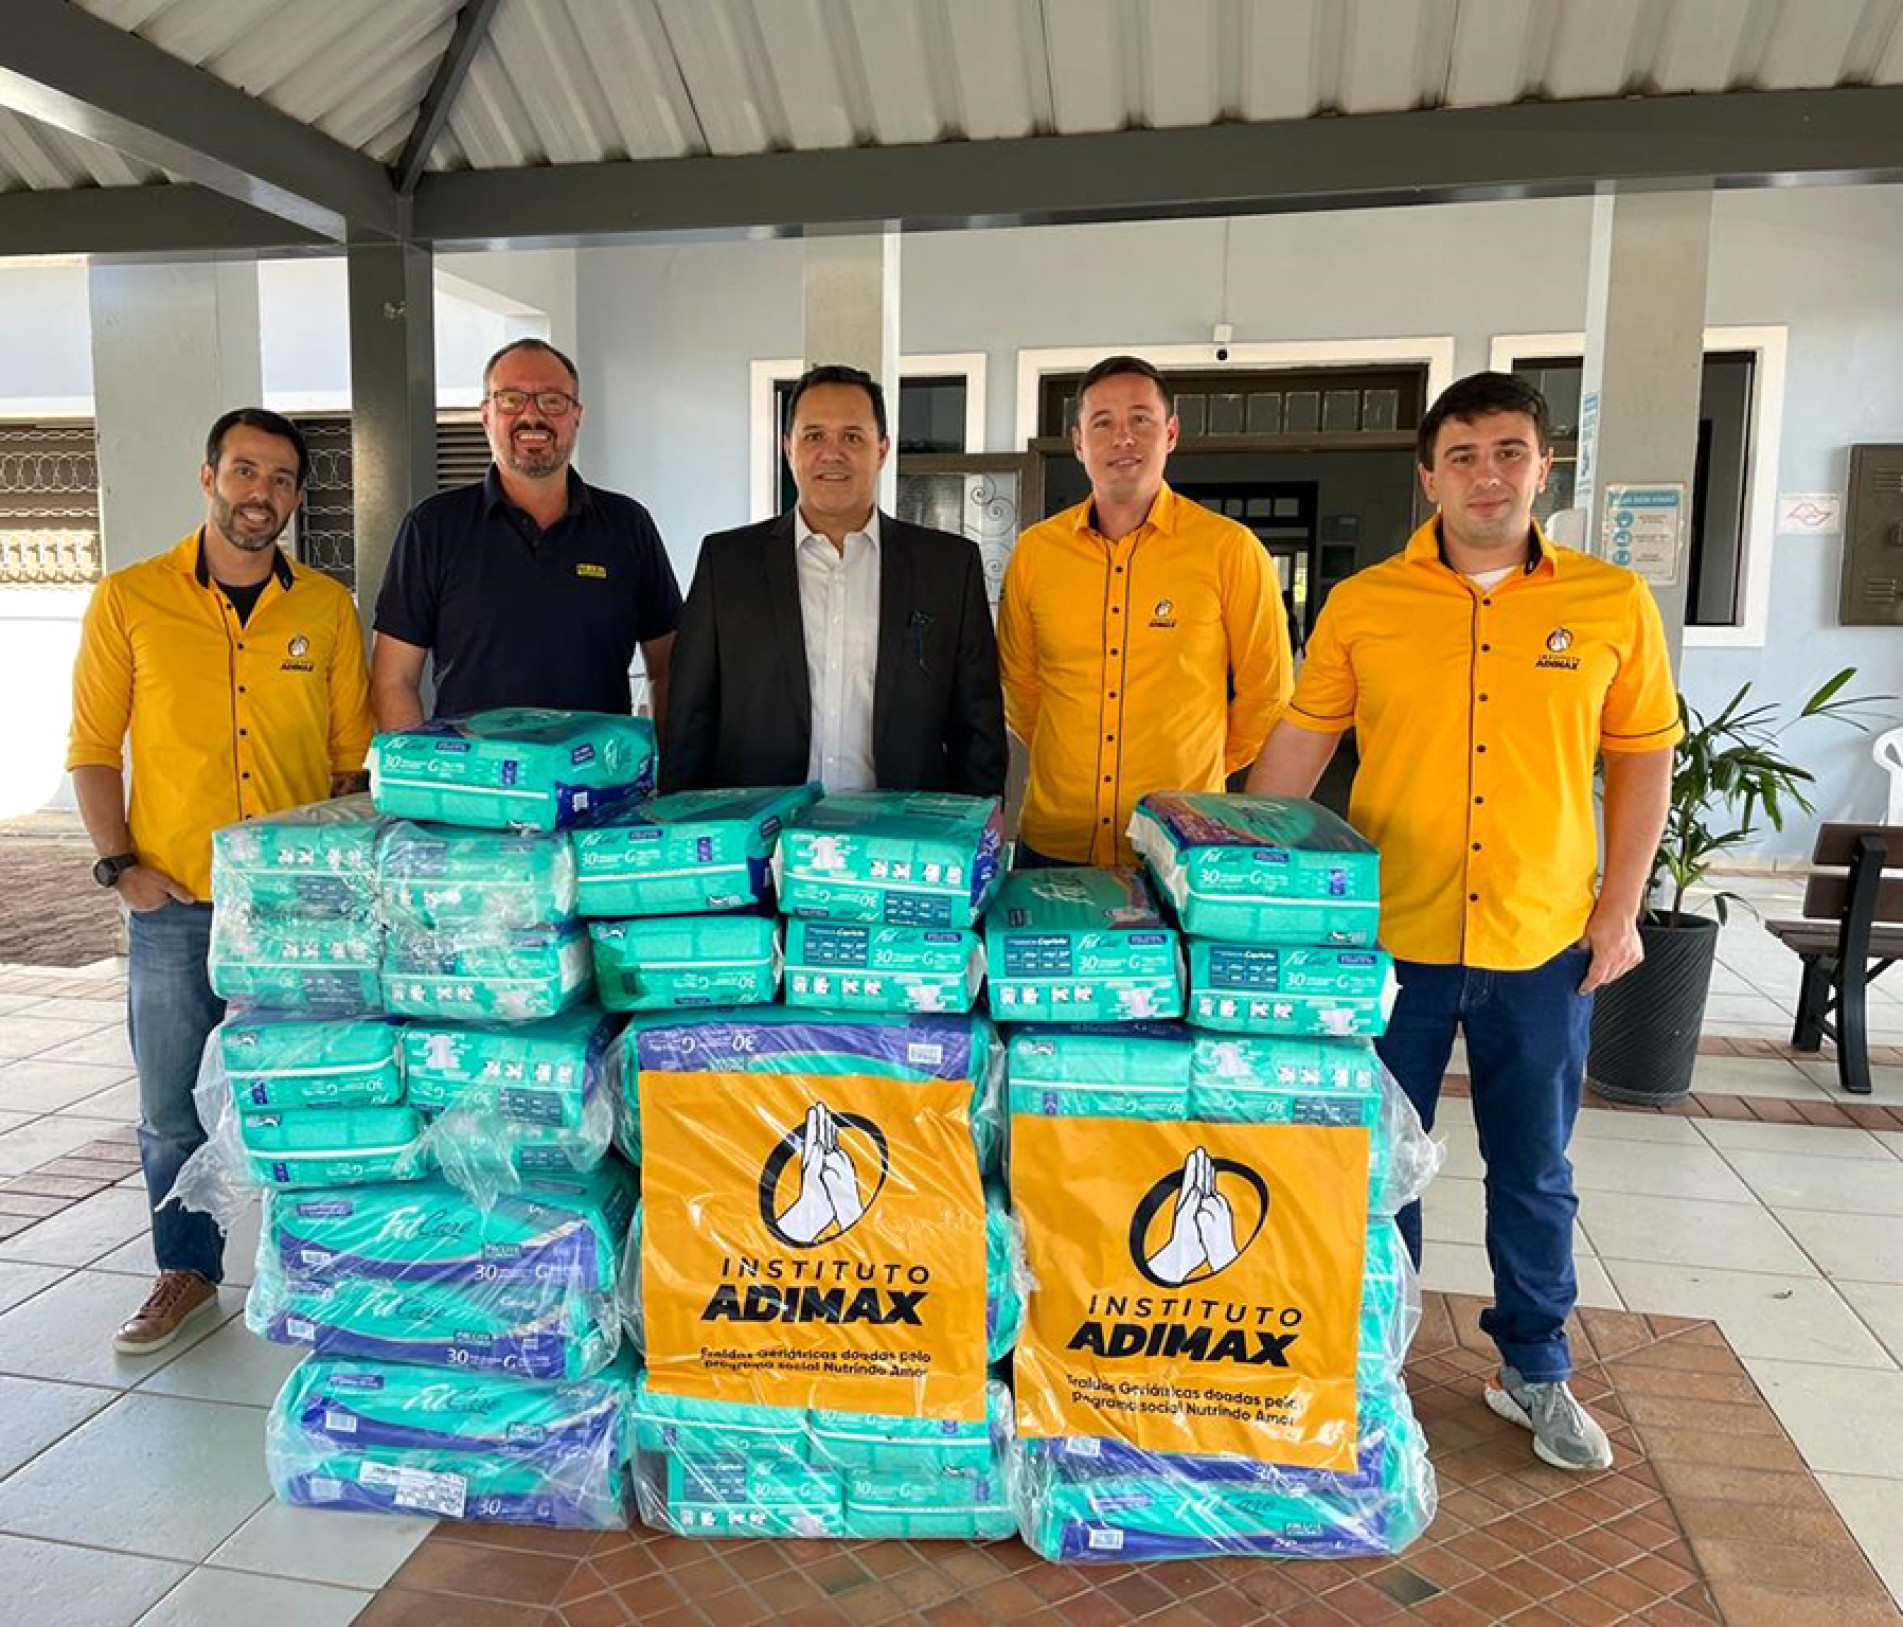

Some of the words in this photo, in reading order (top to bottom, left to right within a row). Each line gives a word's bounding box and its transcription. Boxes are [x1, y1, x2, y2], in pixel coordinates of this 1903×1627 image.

[721, 1257, 930, 1285] INSTITUTO
[700, 1285, 928, 1326] ADIMAX
[1088, 1294, 1302, 1327] INSTITUTO
[1067, 1321, 1299, 1367] ADIMAX
[1186, 1402, 1251, 1422] Nutrindo
